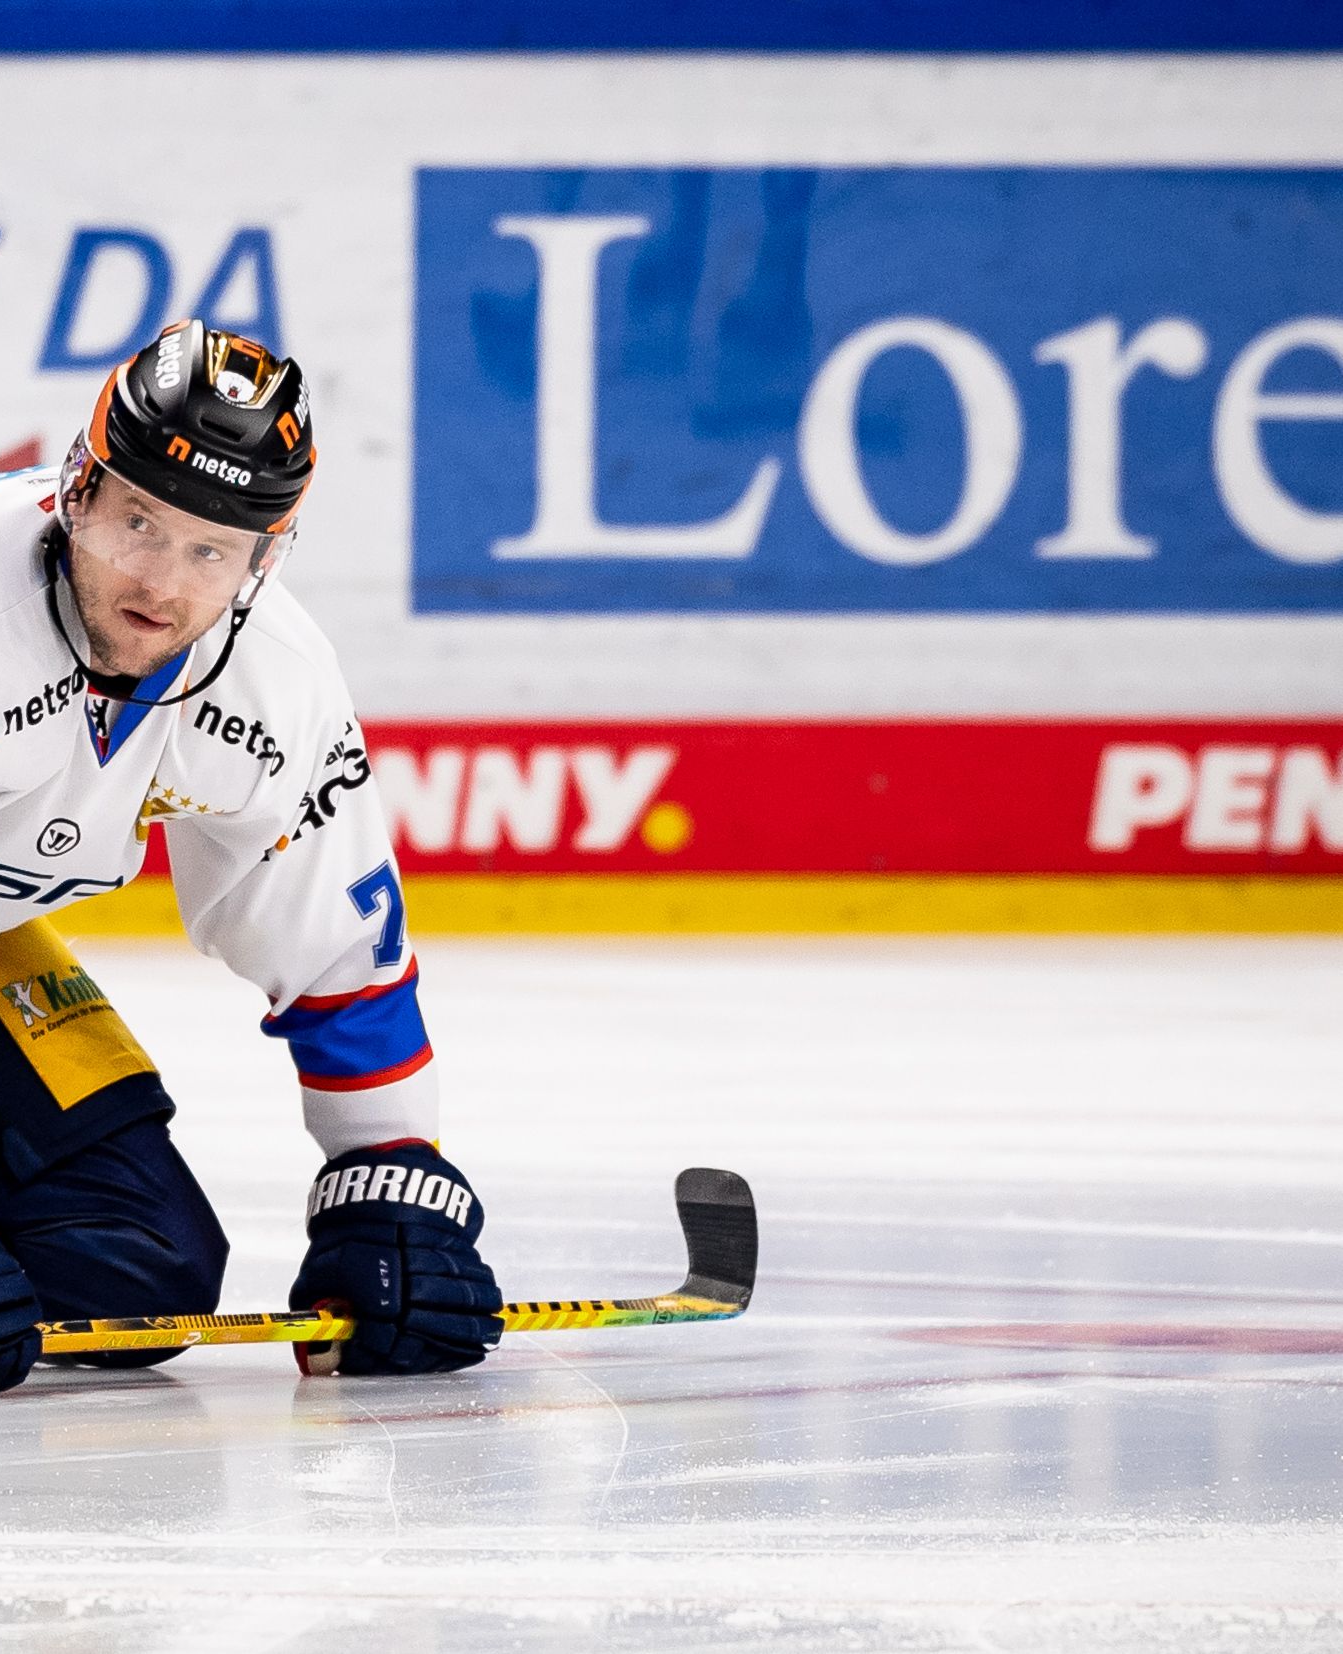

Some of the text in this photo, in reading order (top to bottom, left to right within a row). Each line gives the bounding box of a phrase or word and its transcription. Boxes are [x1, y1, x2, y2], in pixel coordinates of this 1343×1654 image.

[35, 225, 288, 373] DA
[156, 333, 183, 389] netgo
[489, 215, 1343, 566] Lore
[191, 451, 252, 487] netgo
[3, 664, 85, 735] netgo
[193, 700, 285, 777] netgo
[1088, 743, 1343, 856] PEN
[346, 860, 407, 968] 7
